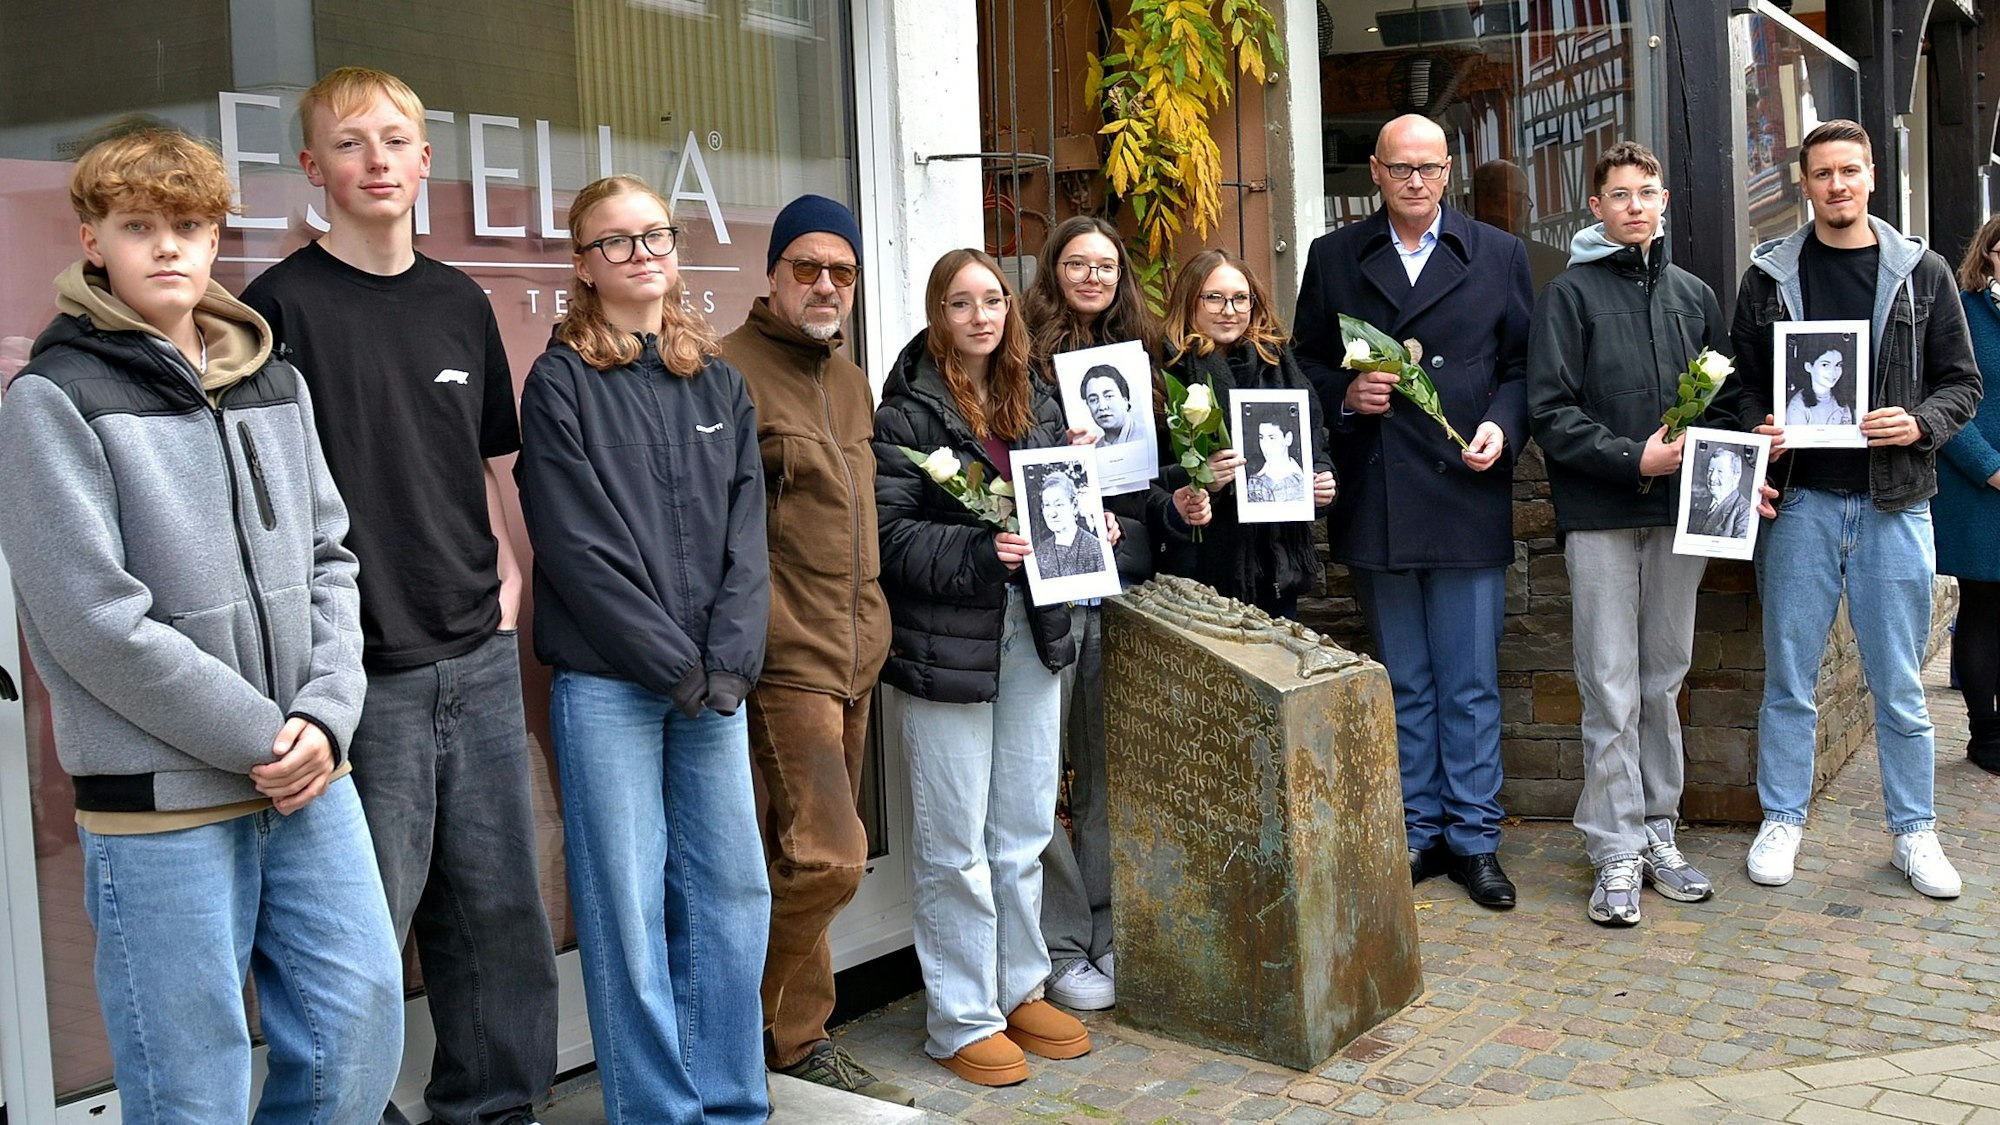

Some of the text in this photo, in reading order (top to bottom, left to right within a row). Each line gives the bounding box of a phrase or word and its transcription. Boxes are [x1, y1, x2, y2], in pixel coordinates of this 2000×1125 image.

[1108, 625, 1278, 720] ERINNERUNG AN DIE
[1109, 679, 1184, 728] UNSERER
